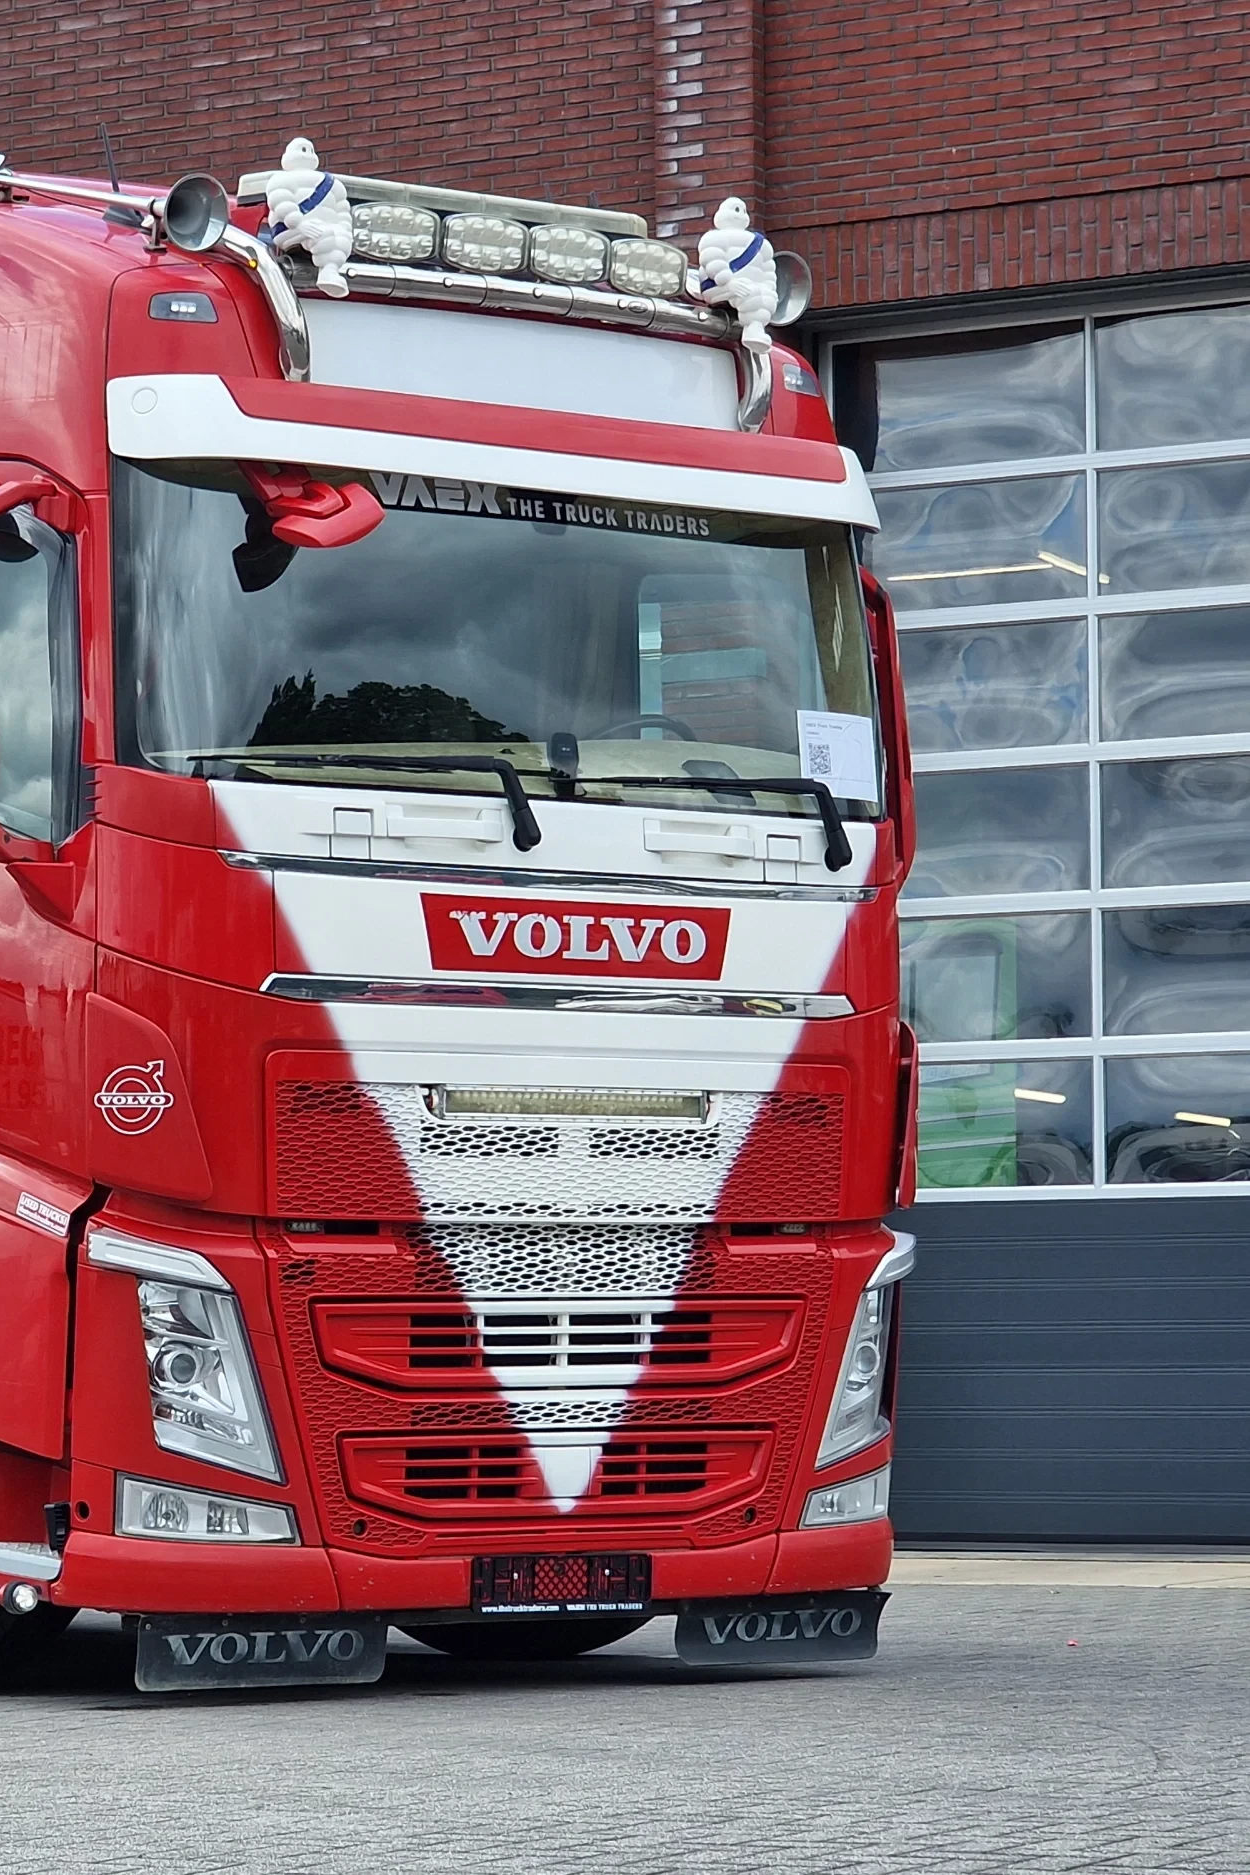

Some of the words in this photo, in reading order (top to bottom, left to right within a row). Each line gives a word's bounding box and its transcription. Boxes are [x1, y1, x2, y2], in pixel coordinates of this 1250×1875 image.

[369, 472, 502, 514] VAEX
[506, 497, 545, 519] THE
[552, 502, 618, 527] TRUCK
[624, 510, 710, 537] TRADERS
[449, 911, 706, 964] VOLVO
[100, 1095, 166, 1105] VOLVO
[700, 1607, 862, 1645] VOLVO
[162, 1629, 364, 1665] VOLVO
